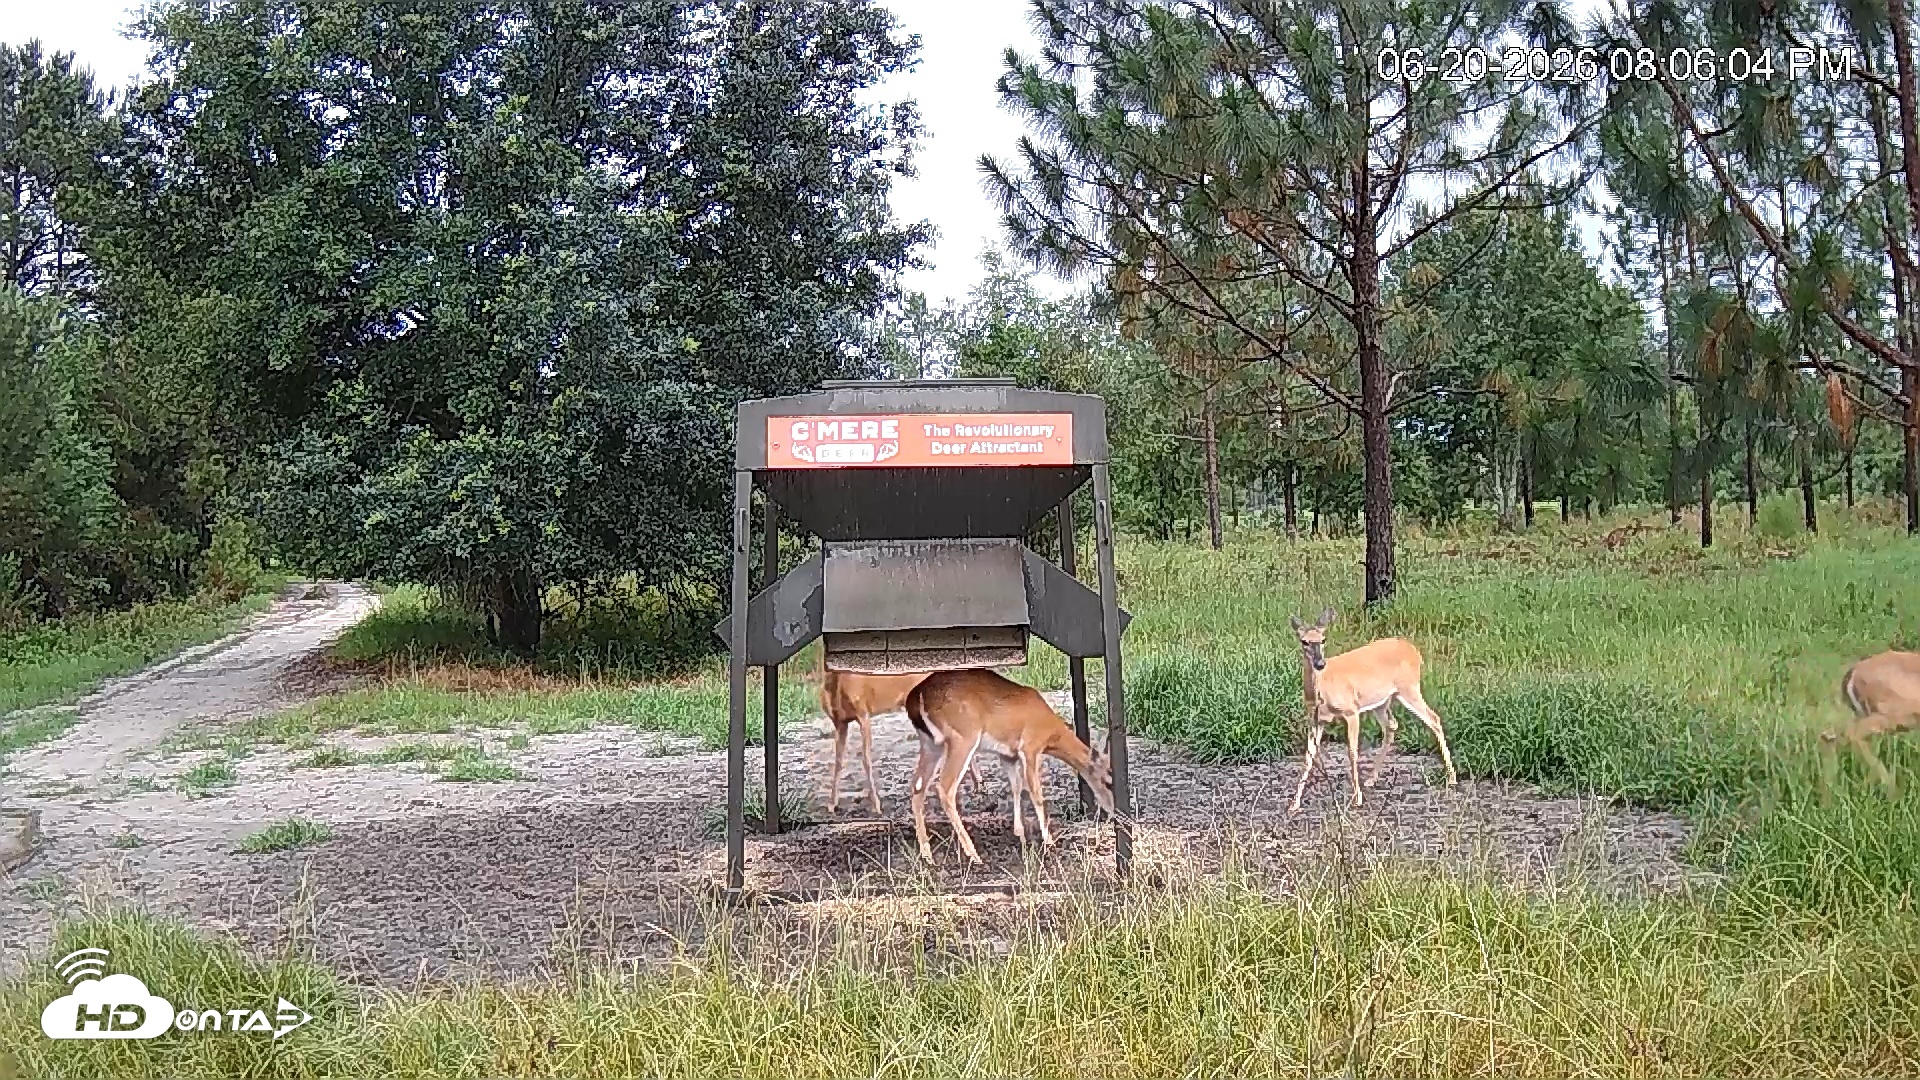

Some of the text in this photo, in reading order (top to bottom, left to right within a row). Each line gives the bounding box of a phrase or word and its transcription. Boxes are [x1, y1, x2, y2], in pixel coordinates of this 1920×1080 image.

[923, 423, 1054, 438] The Revolutionary
[930, 441, 1044, 455] Deer Attractant
